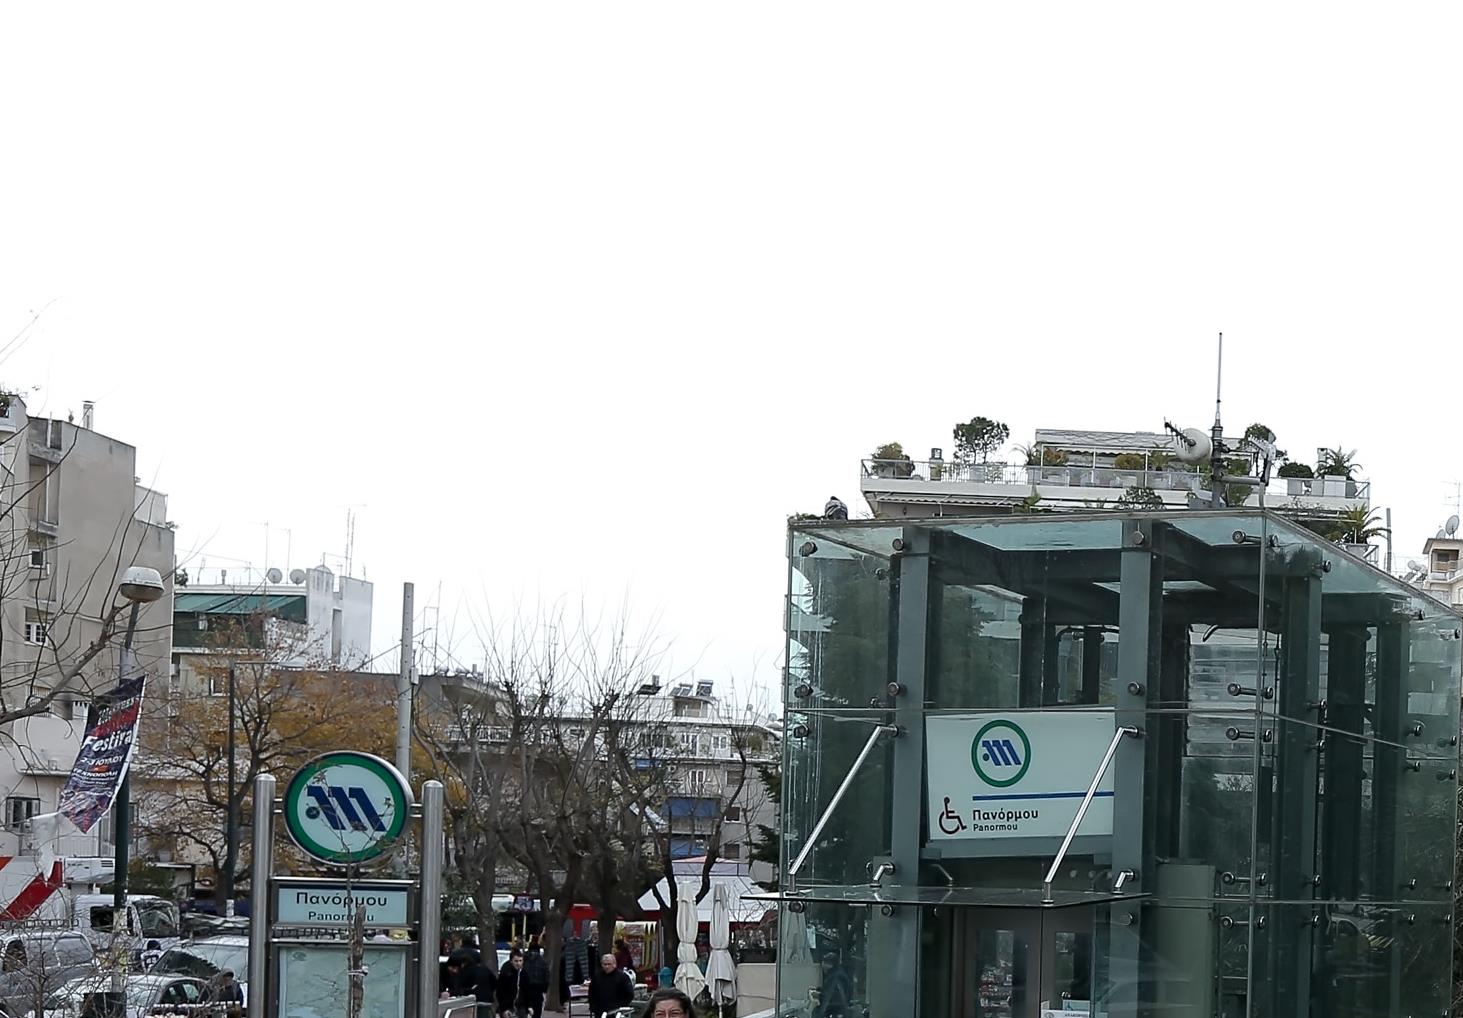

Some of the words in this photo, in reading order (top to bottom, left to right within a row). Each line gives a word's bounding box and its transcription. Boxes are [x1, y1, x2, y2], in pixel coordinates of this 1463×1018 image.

[81, 730, 133, 752] Festiva
[973, 808, 1039, 822] Πανόρμου
[296, 892, 387, 908] Πανόρμου
[308, 911, 374, 922] Panoru
